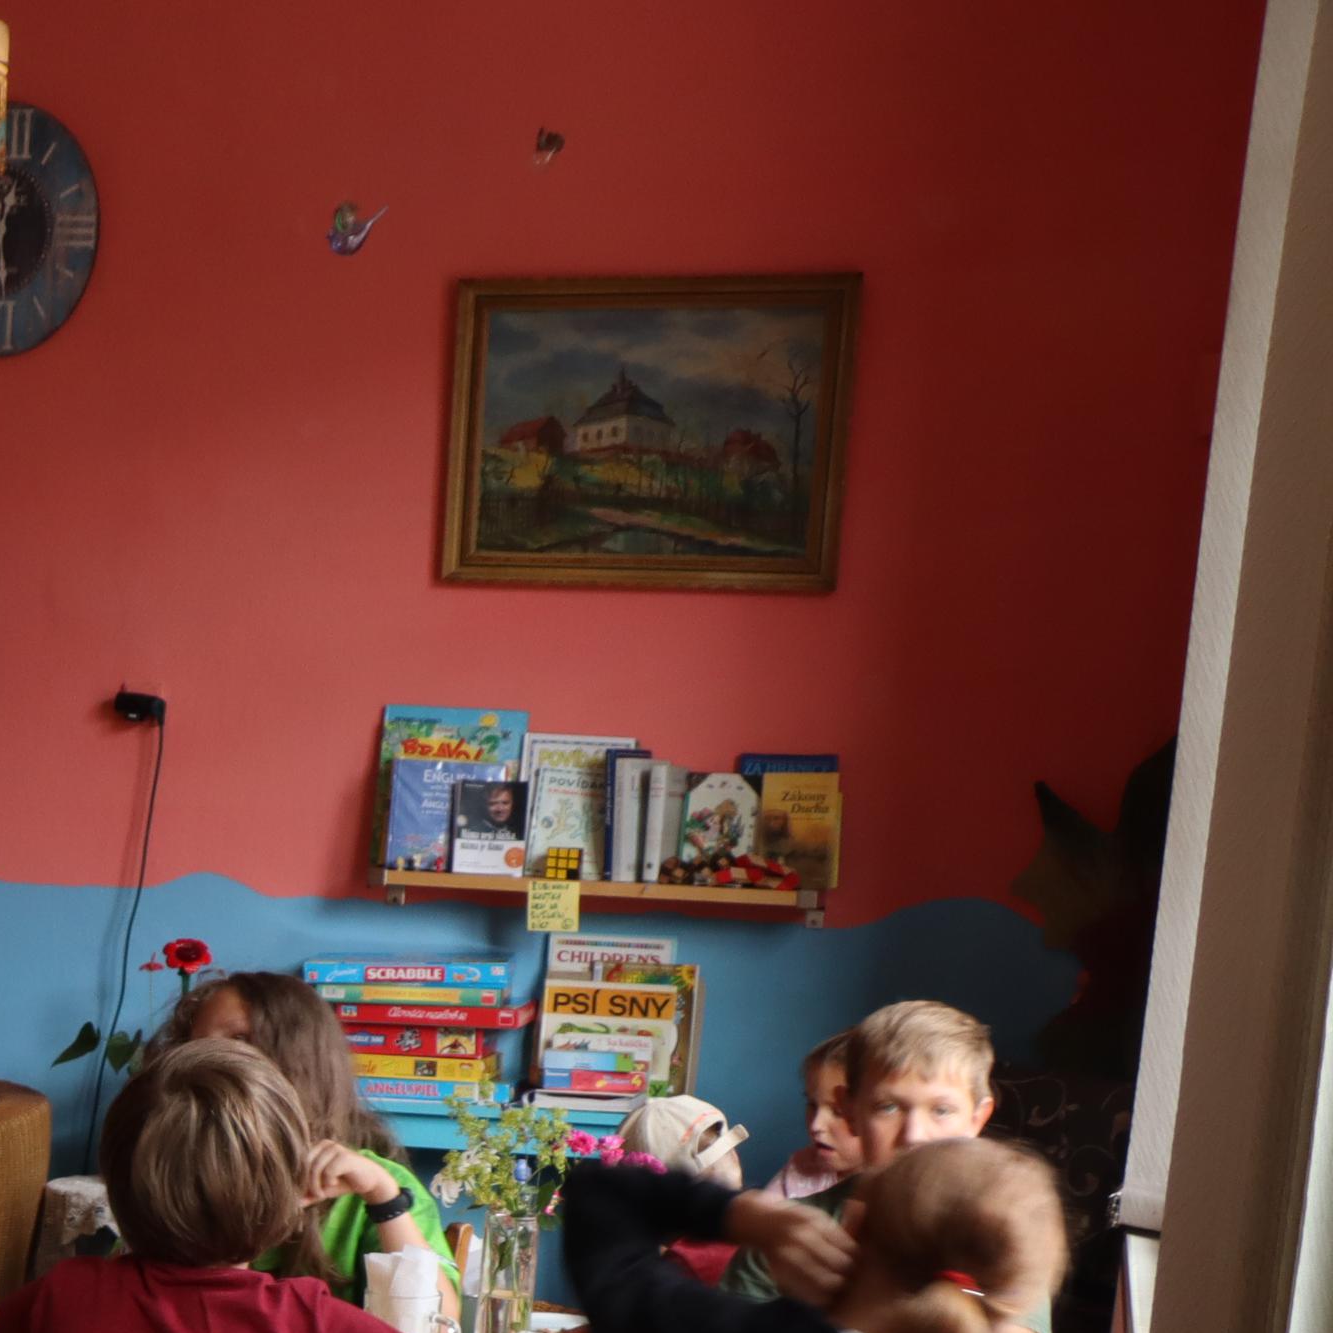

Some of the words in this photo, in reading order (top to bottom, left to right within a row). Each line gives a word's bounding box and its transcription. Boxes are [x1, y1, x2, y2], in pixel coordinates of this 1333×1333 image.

[781, 788, 828, 805] Zákony
[791, 803, 829, 814] Ducha
[366, 967, 442, 980] SCRABBLE
[552, 988, 599, 1015] PSÍ
[608, 993, 671, 1018] SNY
